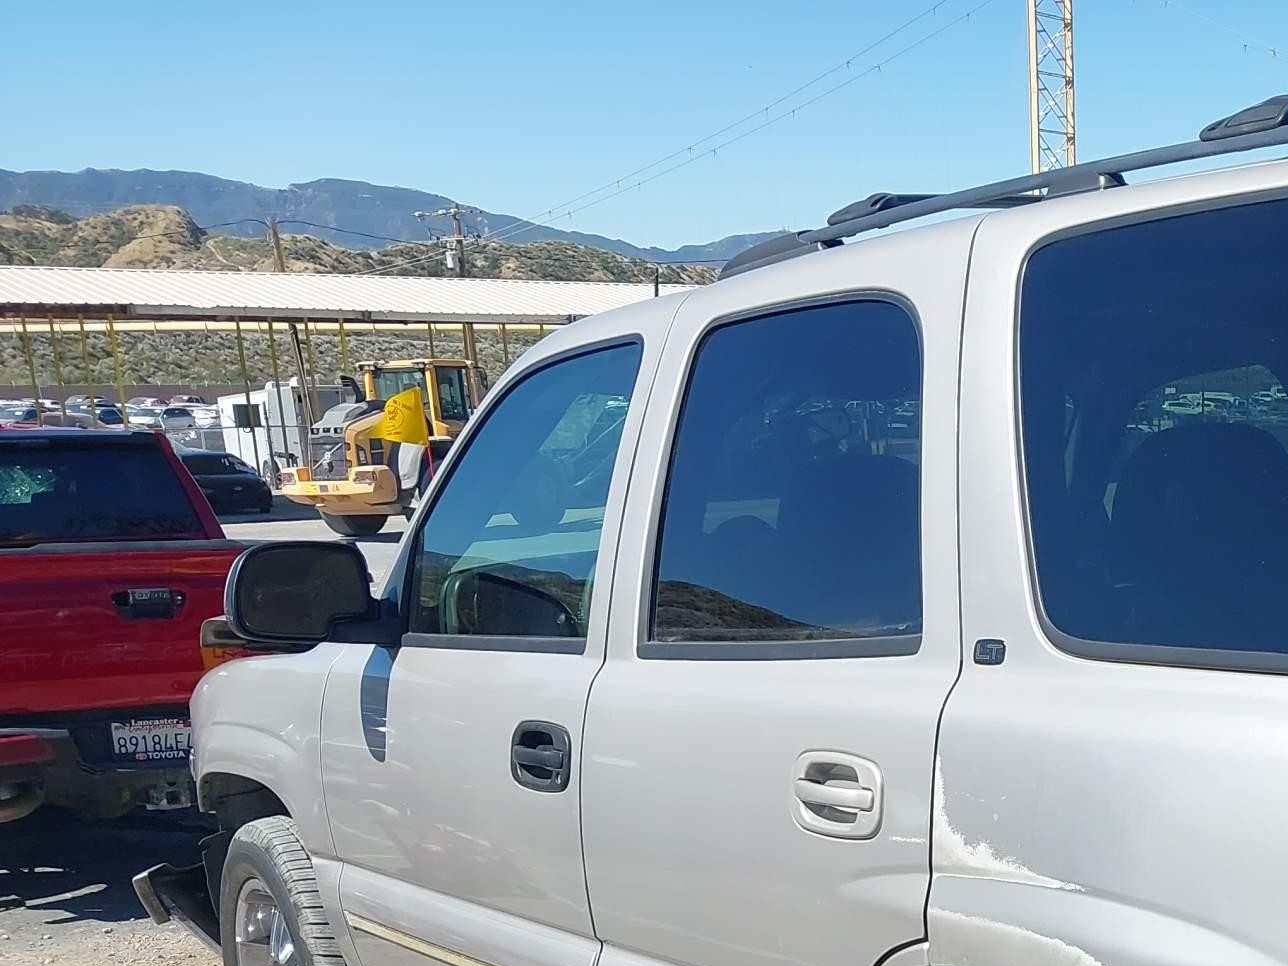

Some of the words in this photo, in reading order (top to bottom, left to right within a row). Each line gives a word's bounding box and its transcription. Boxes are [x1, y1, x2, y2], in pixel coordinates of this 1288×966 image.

[975, 643, 1004, 660] LT
[131, 718, 178, 726] Lancaster
[147, 750, 186, 760] TOYOTA
